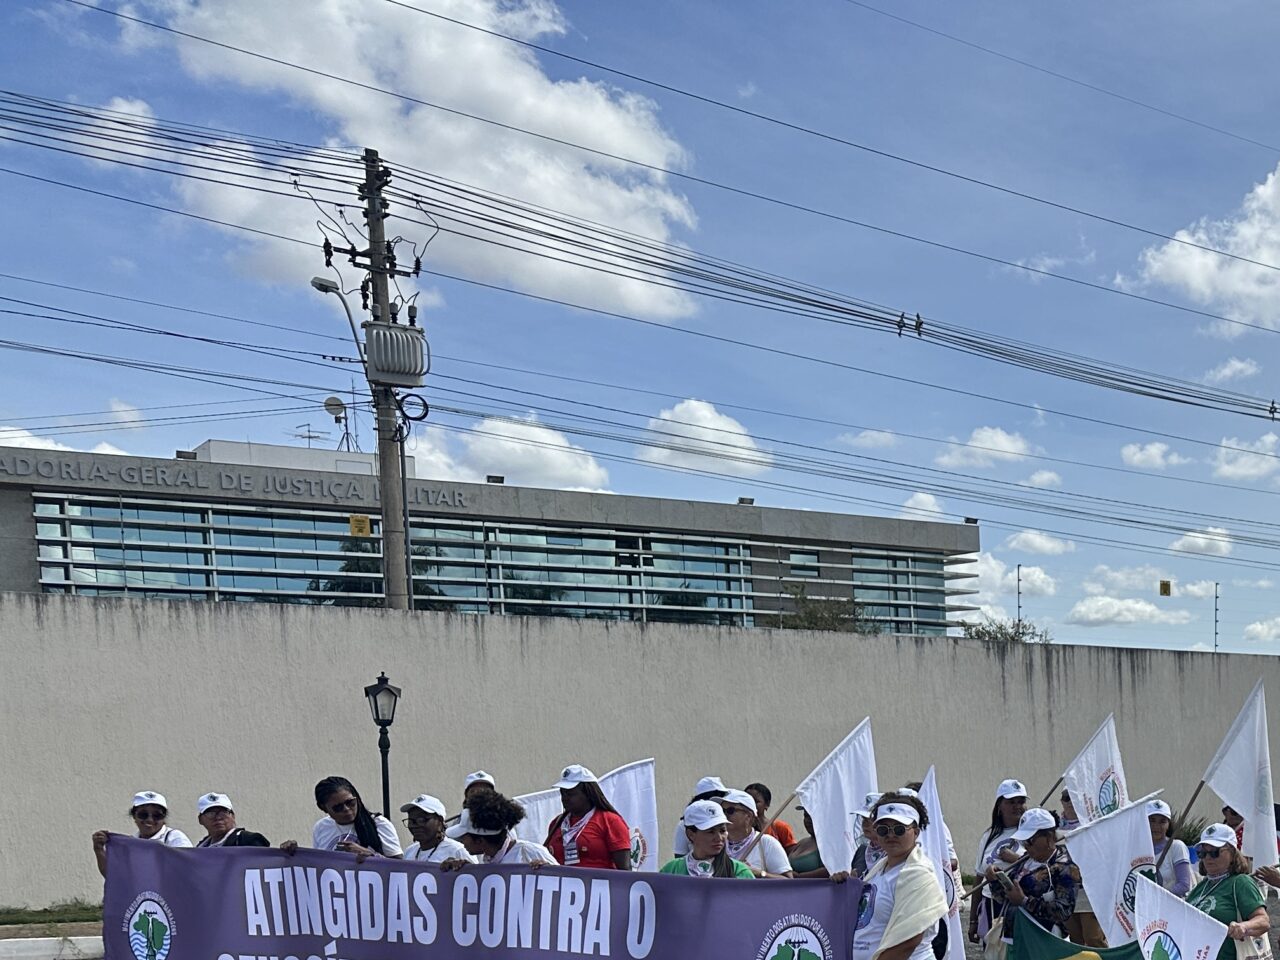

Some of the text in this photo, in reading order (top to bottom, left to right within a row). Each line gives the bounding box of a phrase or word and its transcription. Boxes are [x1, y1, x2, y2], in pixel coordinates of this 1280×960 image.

[220, 471, 253, 492] DE
[263, 473, 364, 503] JUSTIÇA
[244, 867, 657, 960] ATINGIDAS CONTRA O
[772, 919, 784, 933] DOS
[781, 913, 812, 927] ATINGIDOS
